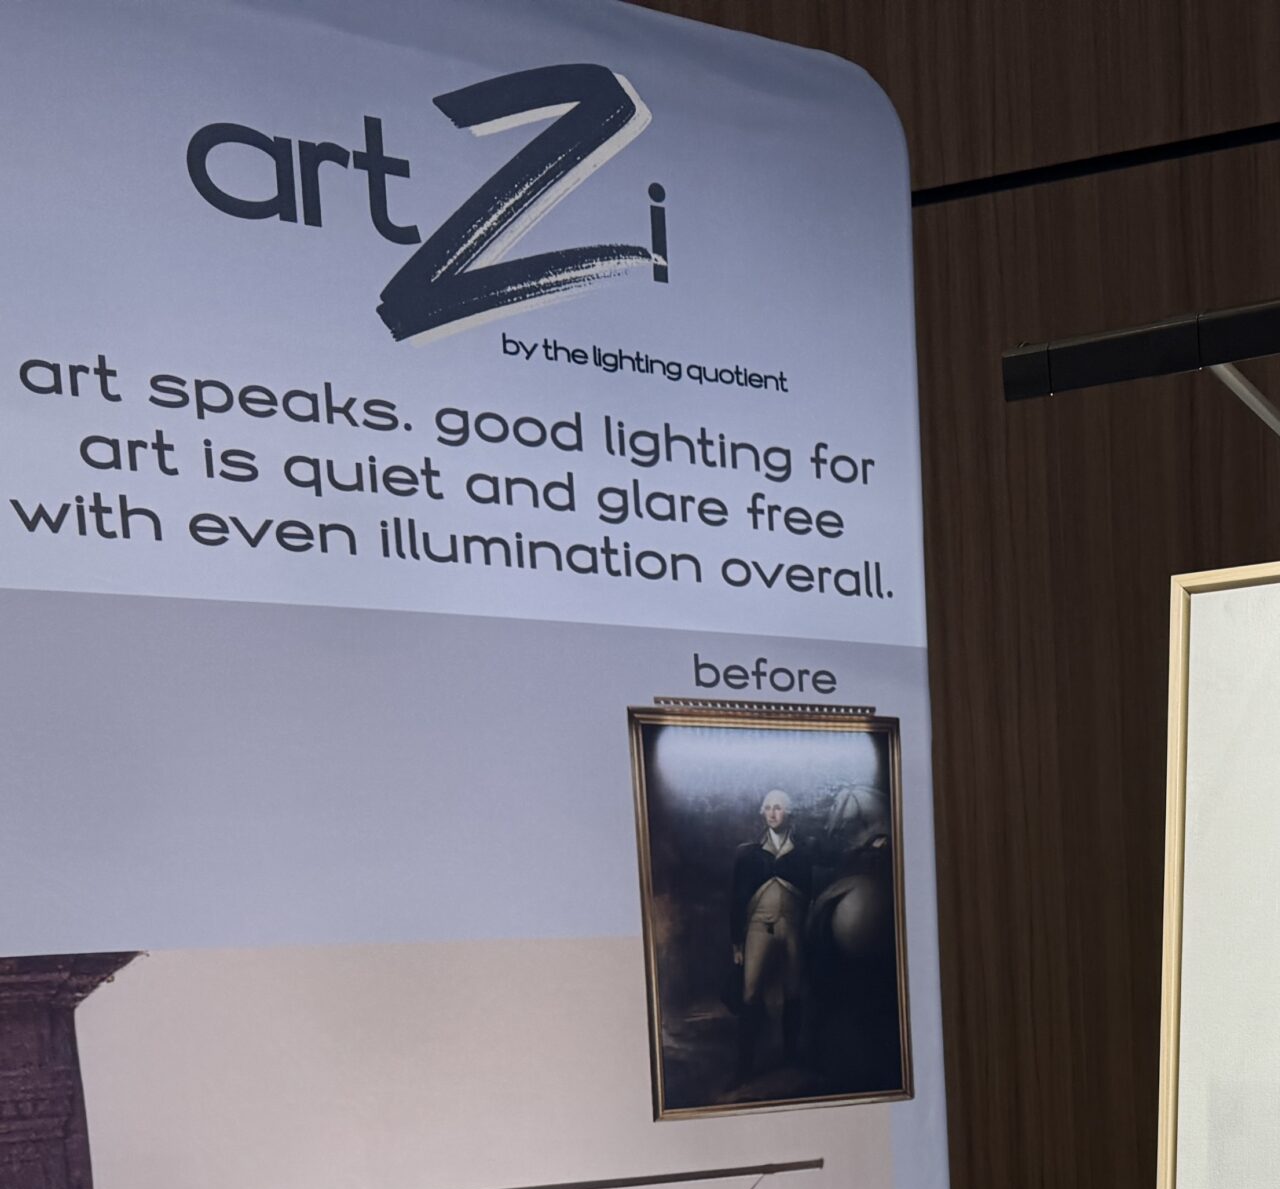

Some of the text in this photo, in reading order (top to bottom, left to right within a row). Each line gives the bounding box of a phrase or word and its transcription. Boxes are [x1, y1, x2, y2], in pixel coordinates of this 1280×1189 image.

[502, 333, 788, 392] by the lighting quotient
[20, 354, 874, 485] art speaks. good lighting for
[80, 430, 844, 539] art is quiet and glare free
[9, 494, 894, 599] with even illumination overall.
[694, 652, 837, 695] before
